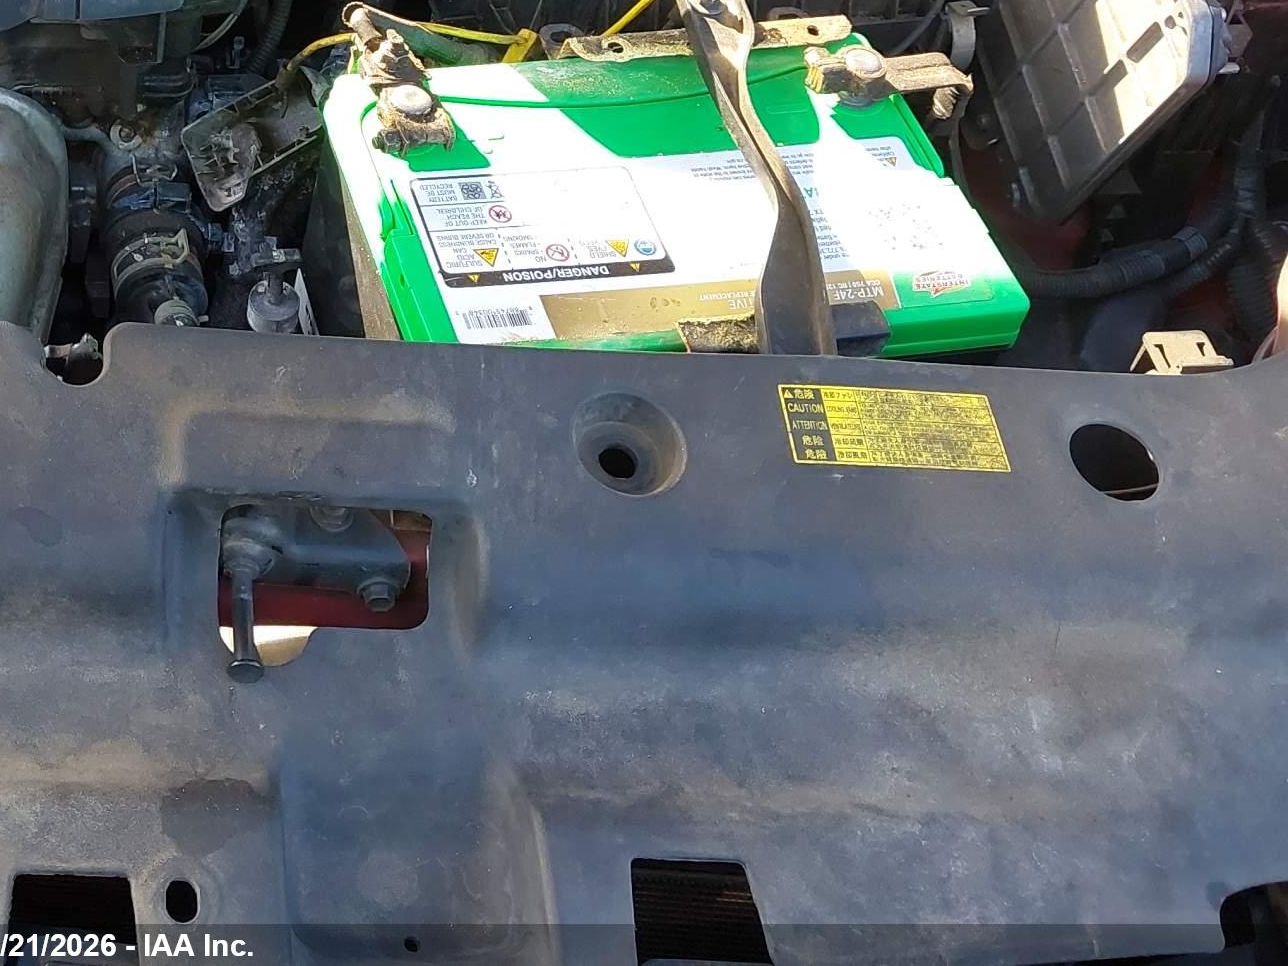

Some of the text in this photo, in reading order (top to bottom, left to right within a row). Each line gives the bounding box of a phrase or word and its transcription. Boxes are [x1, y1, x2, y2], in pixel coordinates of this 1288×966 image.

[419, 183, 453, 192] RECYCLED
[446, 260, 483, 268] SULFURIC
[502, 265, 610, 282] DANGER/POISON
[915, 279, 968, 290] INTERSTATE
[834, 286, 884, 300] MTP-24F
[787, 403, 824, 413] CAUTION
[793, 420, 827, 430] ATTENTION
